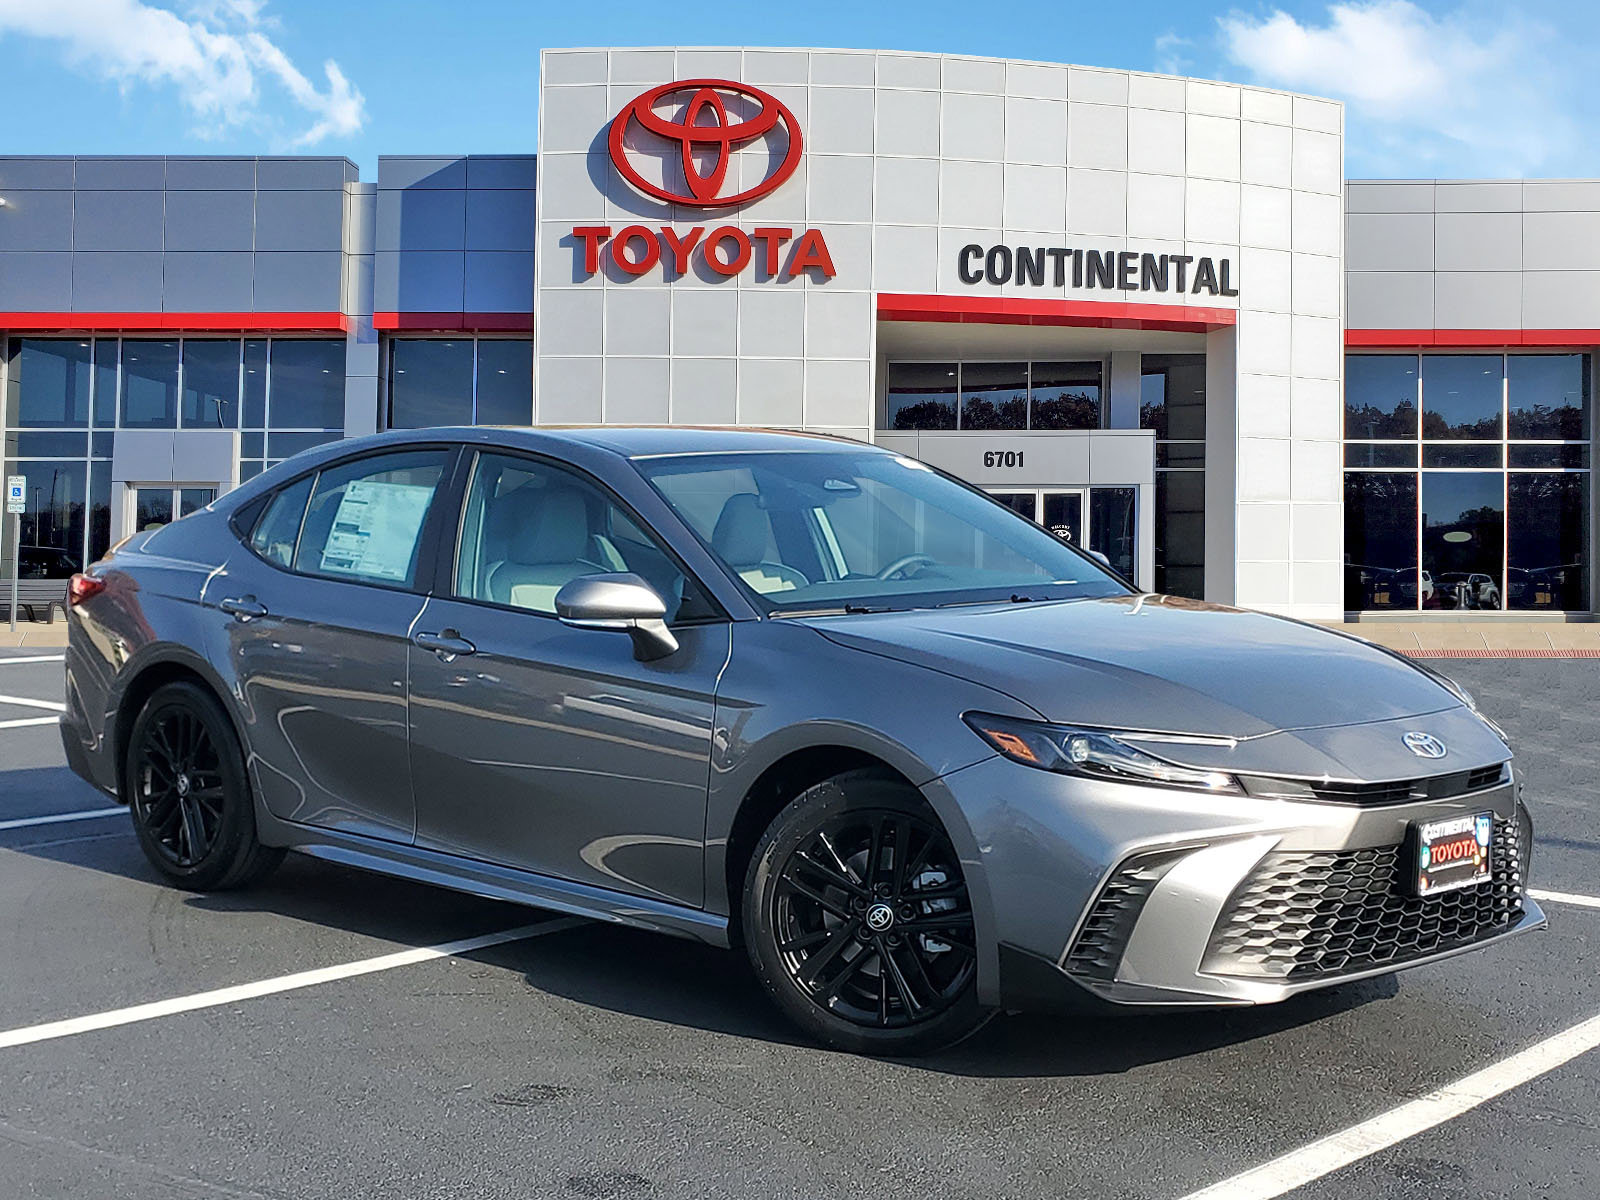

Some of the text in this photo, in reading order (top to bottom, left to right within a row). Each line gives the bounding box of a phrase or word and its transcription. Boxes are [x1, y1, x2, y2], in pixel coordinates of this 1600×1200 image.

[572, 225, 837, 277] TOYOTA
[958, 244, 1239, 296] CONTINENTAL
[983, 451, 1024, 468] 6701
[1430, 839, 1479, 864] TOYOTA
